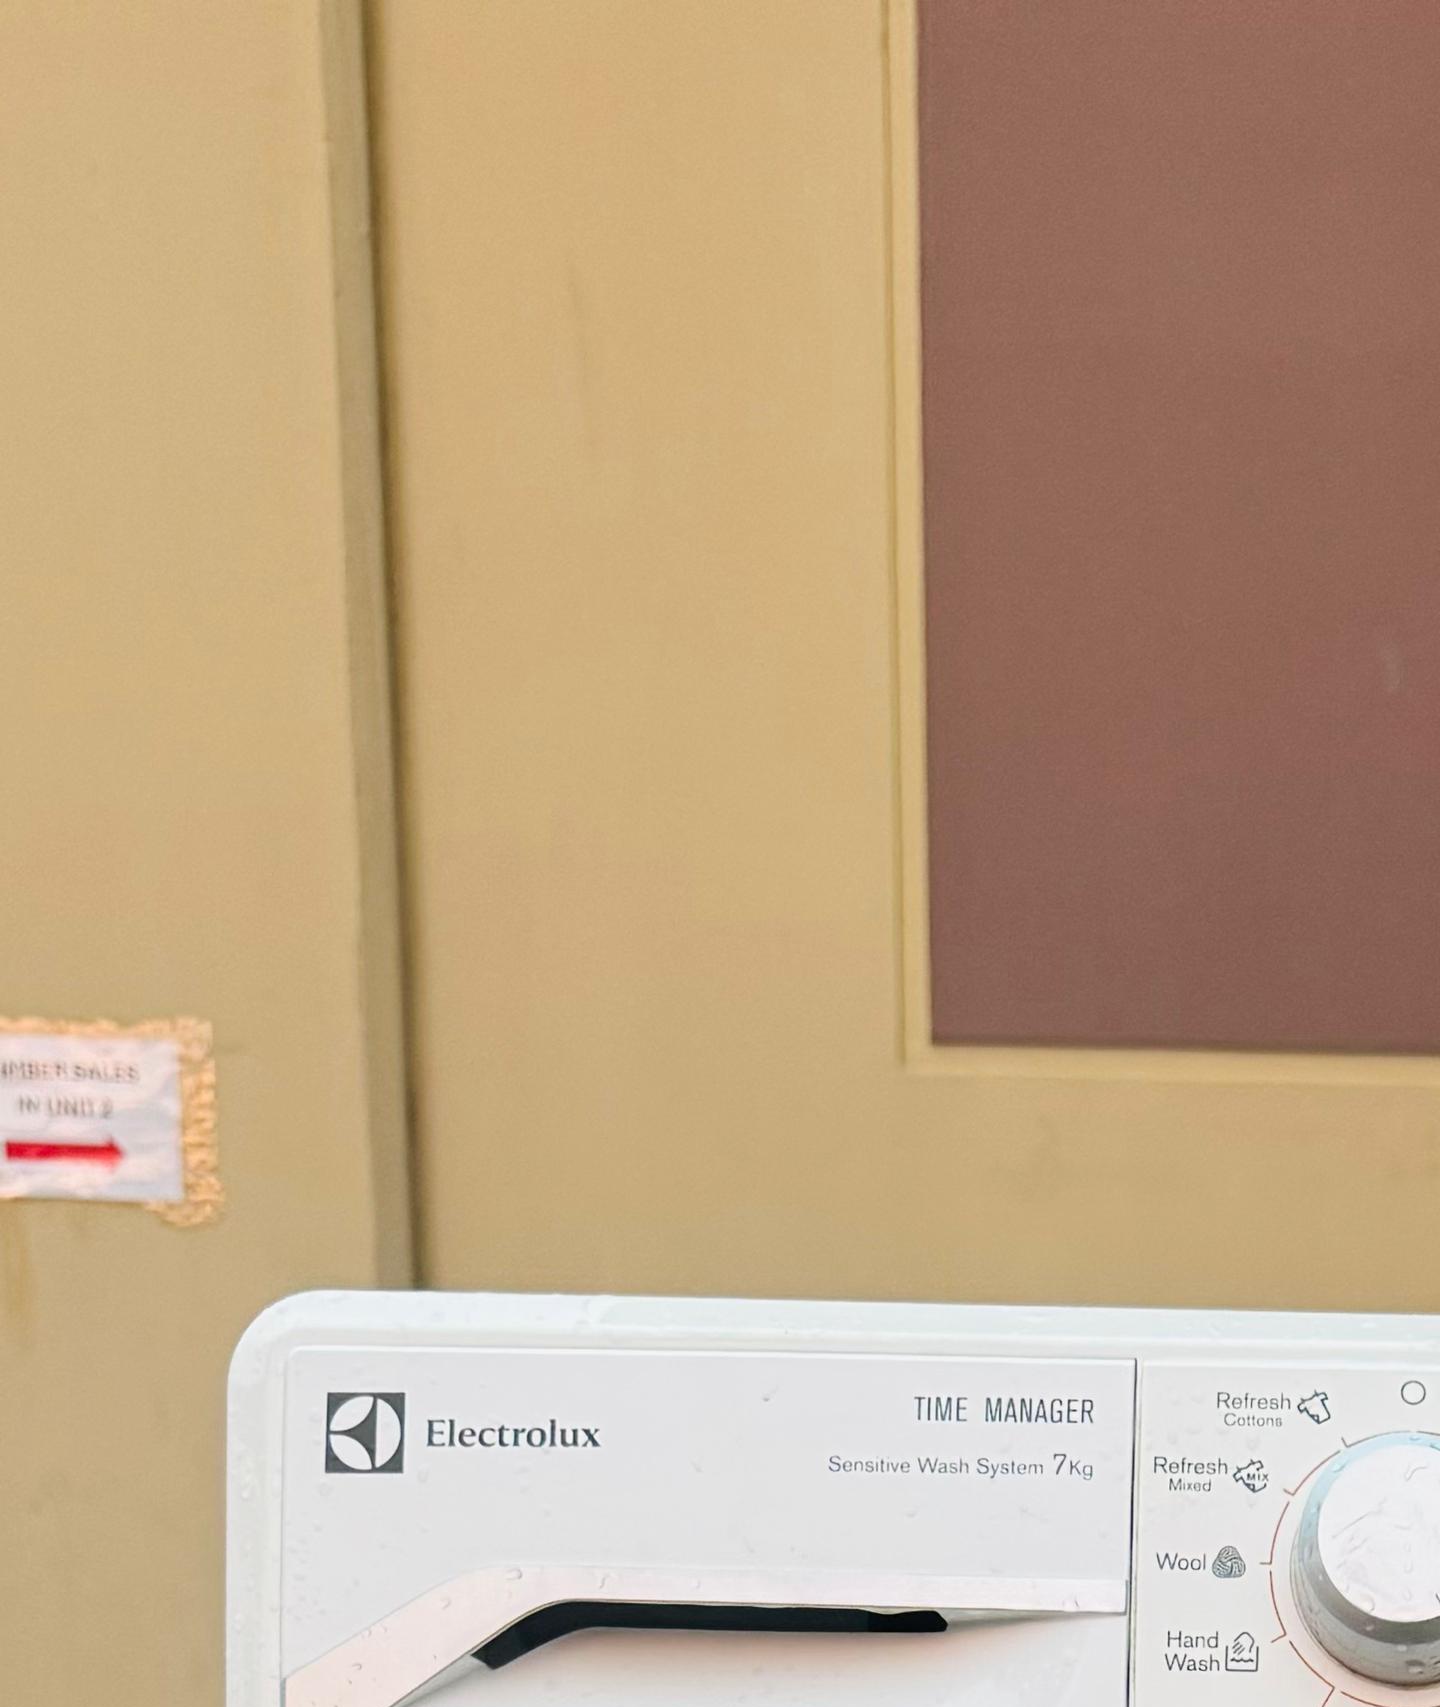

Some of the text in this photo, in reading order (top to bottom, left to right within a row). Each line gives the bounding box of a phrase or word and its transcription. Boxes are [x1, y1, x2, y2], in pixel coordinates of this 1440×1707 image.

[914, 1396, 1094, 1424] TIME MANAGER
[1217, 1392, 1291, 1410] Refresh
[1223, 1413, 1283, 1427] Cottons
[426, 1418, 602, 1448] Electrolux
[828, 1455, 911, 1474] Sensitive
[917, 1457, 969, 1474] Wash
[976, 1457, 1044, 1479] System
[1153, 1456, 1228, 1475] Refresh
[1168, 1478, 1212, 1492] Mixed
[1156, 1552, 1207, 1571] Wool
[1166, 1631, 1219, 1649] Hand
[1164, 1654, 1220, 1671] Wash
